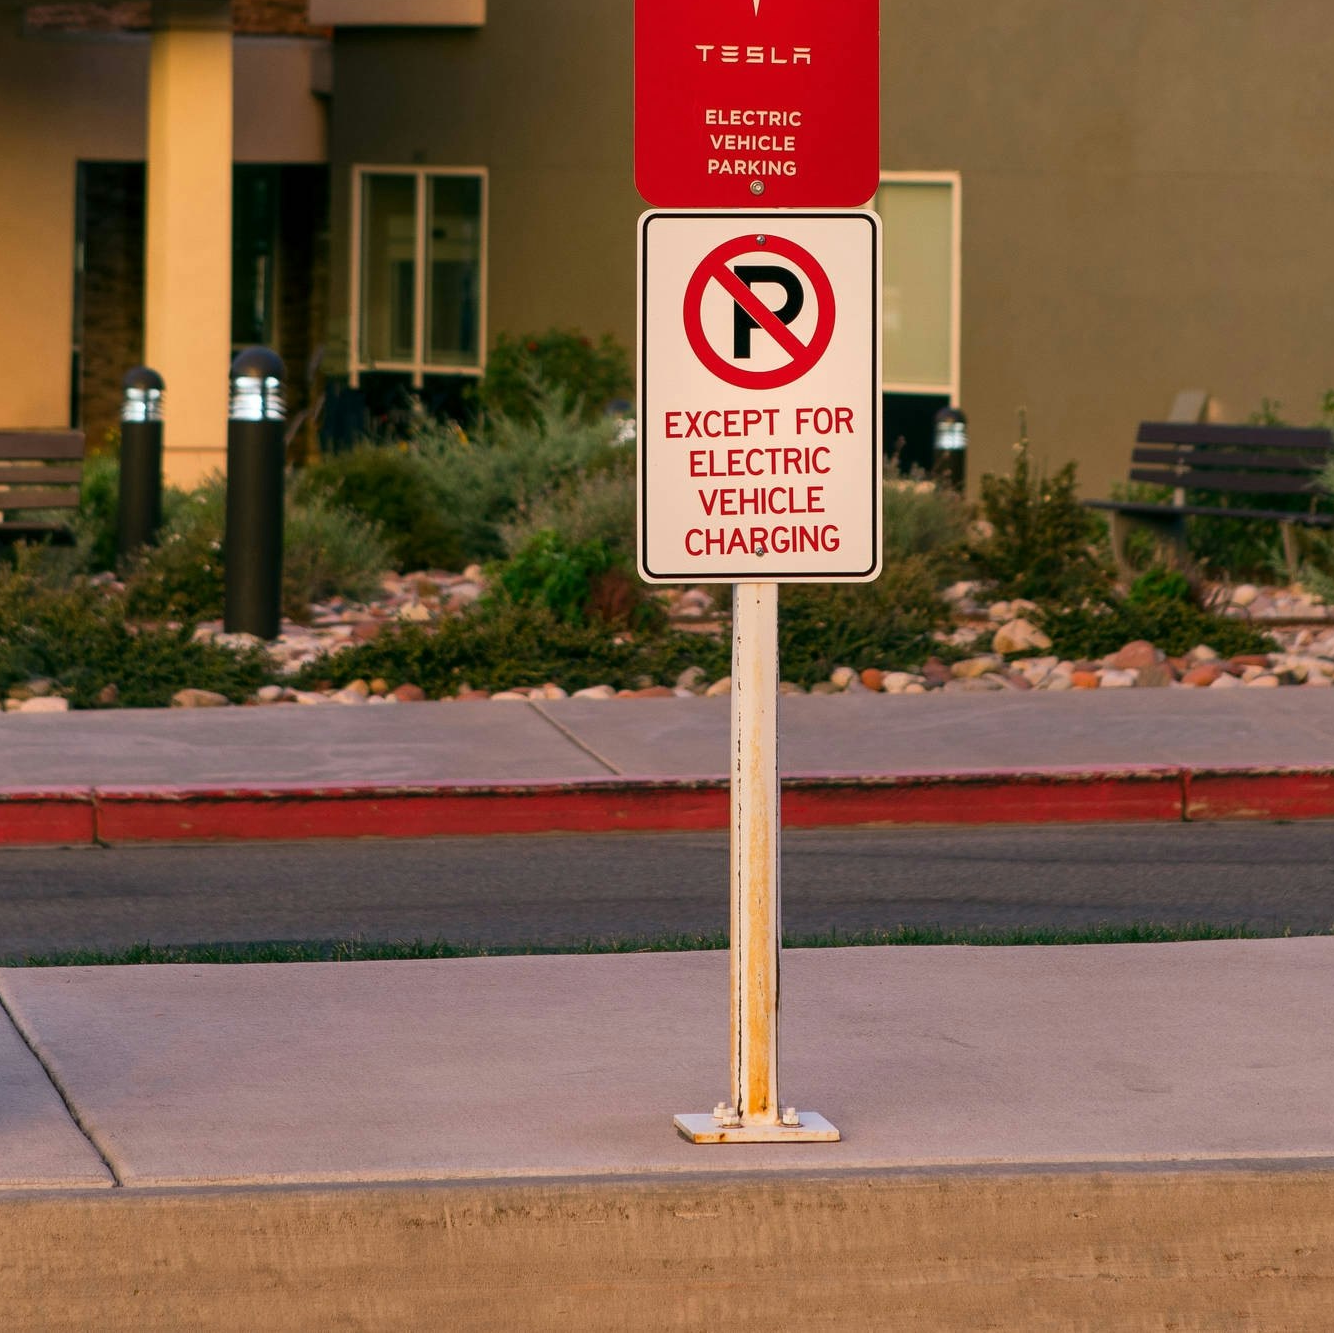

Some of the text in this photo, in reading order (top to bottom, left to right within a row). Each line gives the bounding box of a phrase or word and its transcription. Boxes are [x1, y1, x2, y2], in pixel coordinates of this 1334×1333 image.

[695, 44, 811, 65] TESLA
[705, 109, 802, 127] ELECTRIC
[709, 134, 796, 152] VEHICLE
[707, 158, 797, 177] PARKING
[665, 406, 854, 439] EXCEPT FOR
[689, 446, 831, 478] ELECTRIC
[698, 485, 825, 516] VEHICLE
[684, 524, 840, 556] CHARGING
